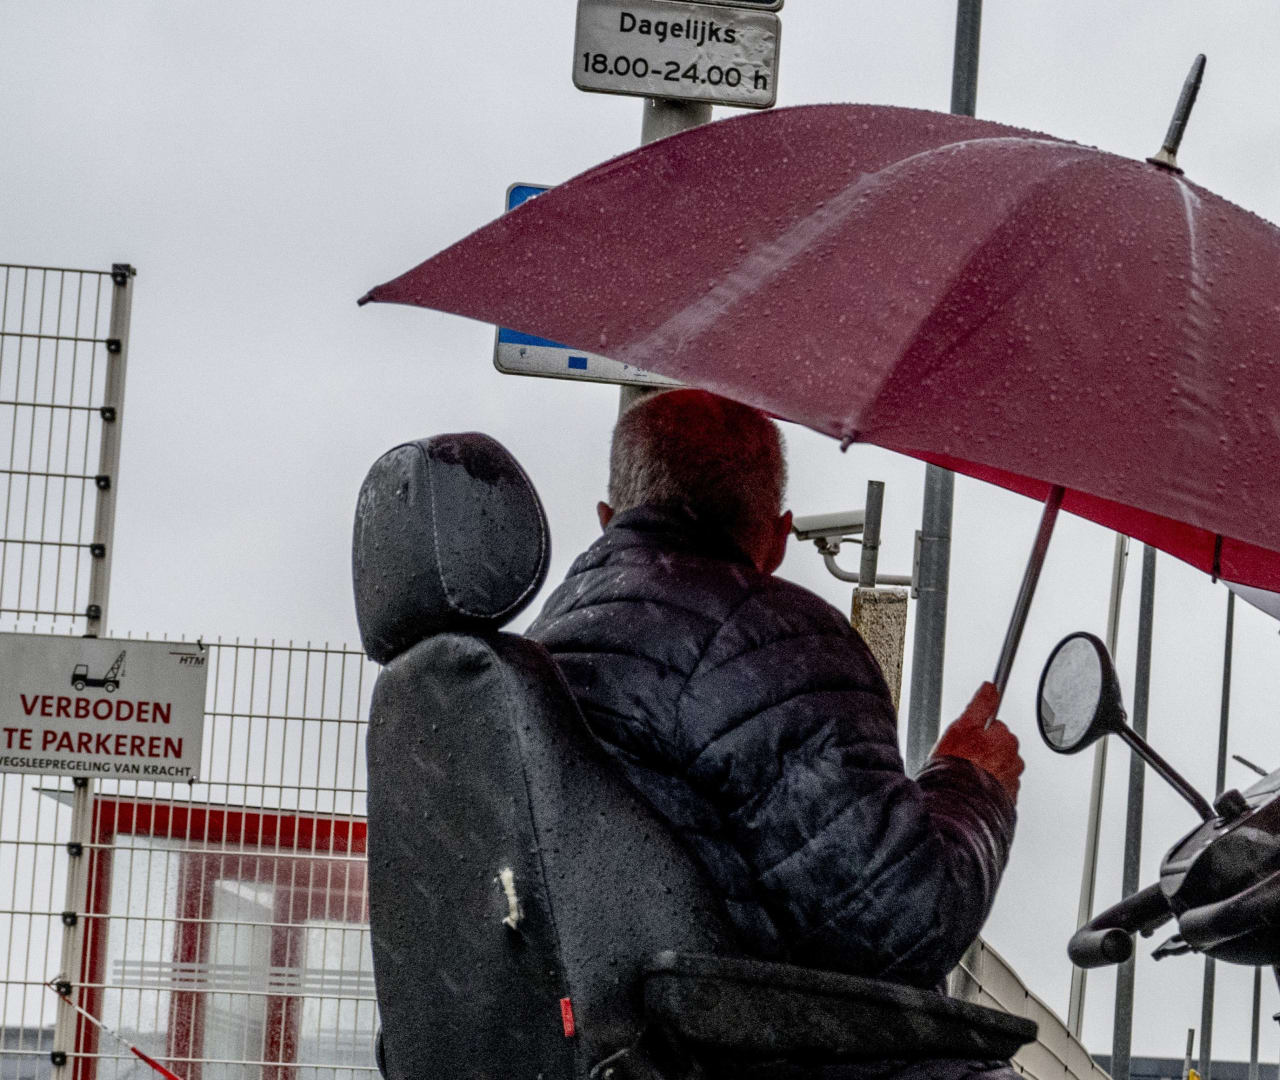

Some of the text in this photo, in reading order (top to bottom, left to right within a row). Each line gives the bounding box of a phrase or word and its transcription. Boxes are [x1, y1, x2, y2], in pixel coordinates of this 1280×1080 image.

[620, 12, 736, 46] Dagelijks
[583, 52, 769, 91] 18.00-24.00 h
[179, 656, 205, 665] HTM
[20, 694, 172, 724] VERBODEN
[3, 728, 183, 759] TE PARKEREN
[114, 763, 140, 774] VAN
[143, 765, 192, 777] KRACHT
